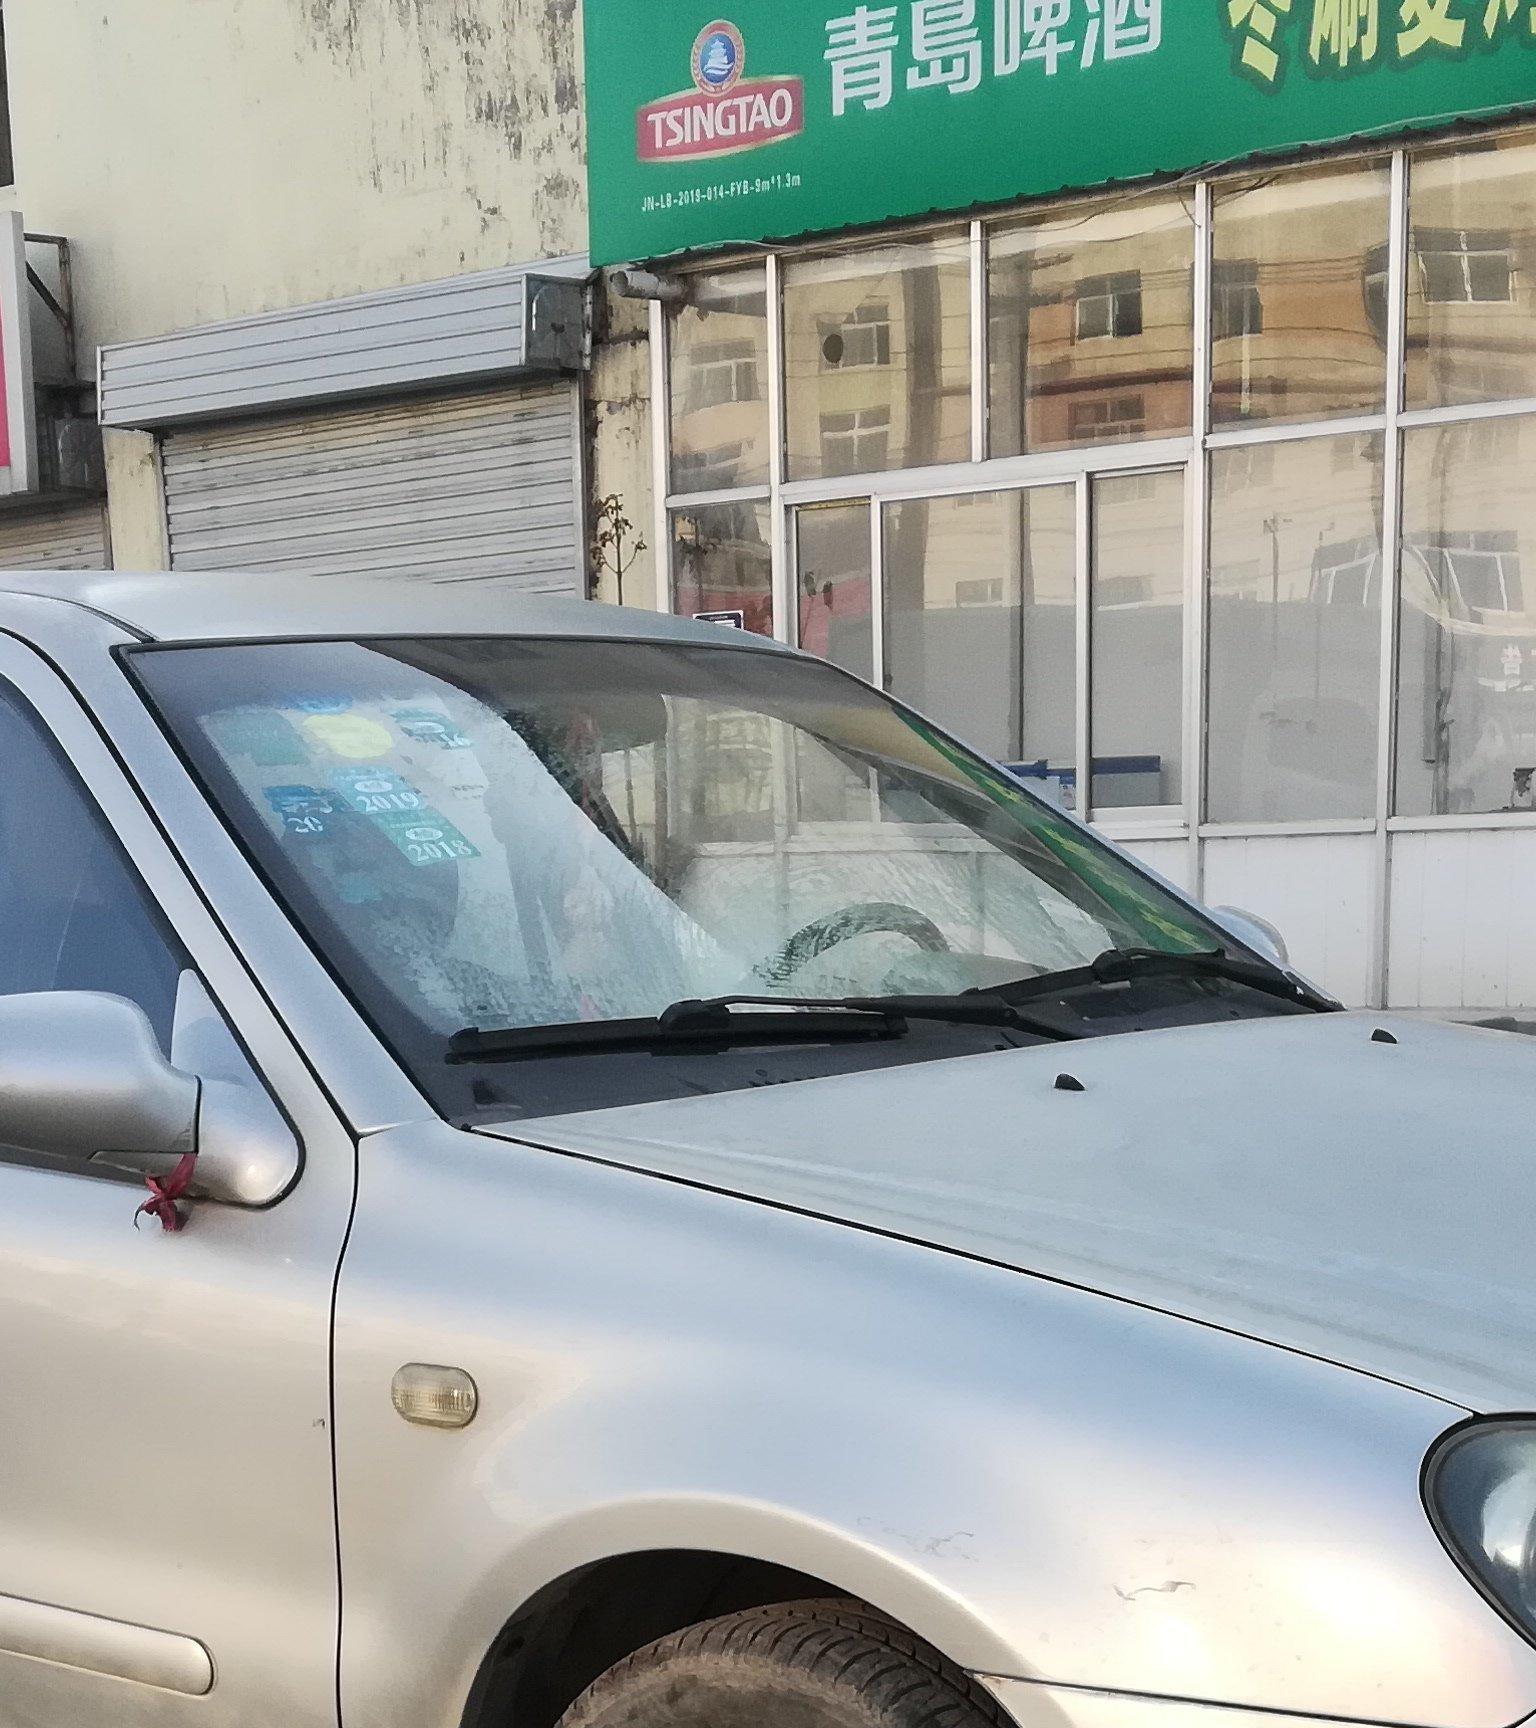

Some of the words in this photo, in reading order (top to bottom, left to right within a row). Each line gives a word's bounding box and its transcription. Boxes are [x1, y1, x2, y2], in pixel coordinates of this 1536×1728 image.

[824, 0, 1162, 116] 青岛啤酒
[646, 88, 792, 149] TSINGTAO
[356, 791, 419, 812] 2019
[407, 839, 472, 862] 2018
